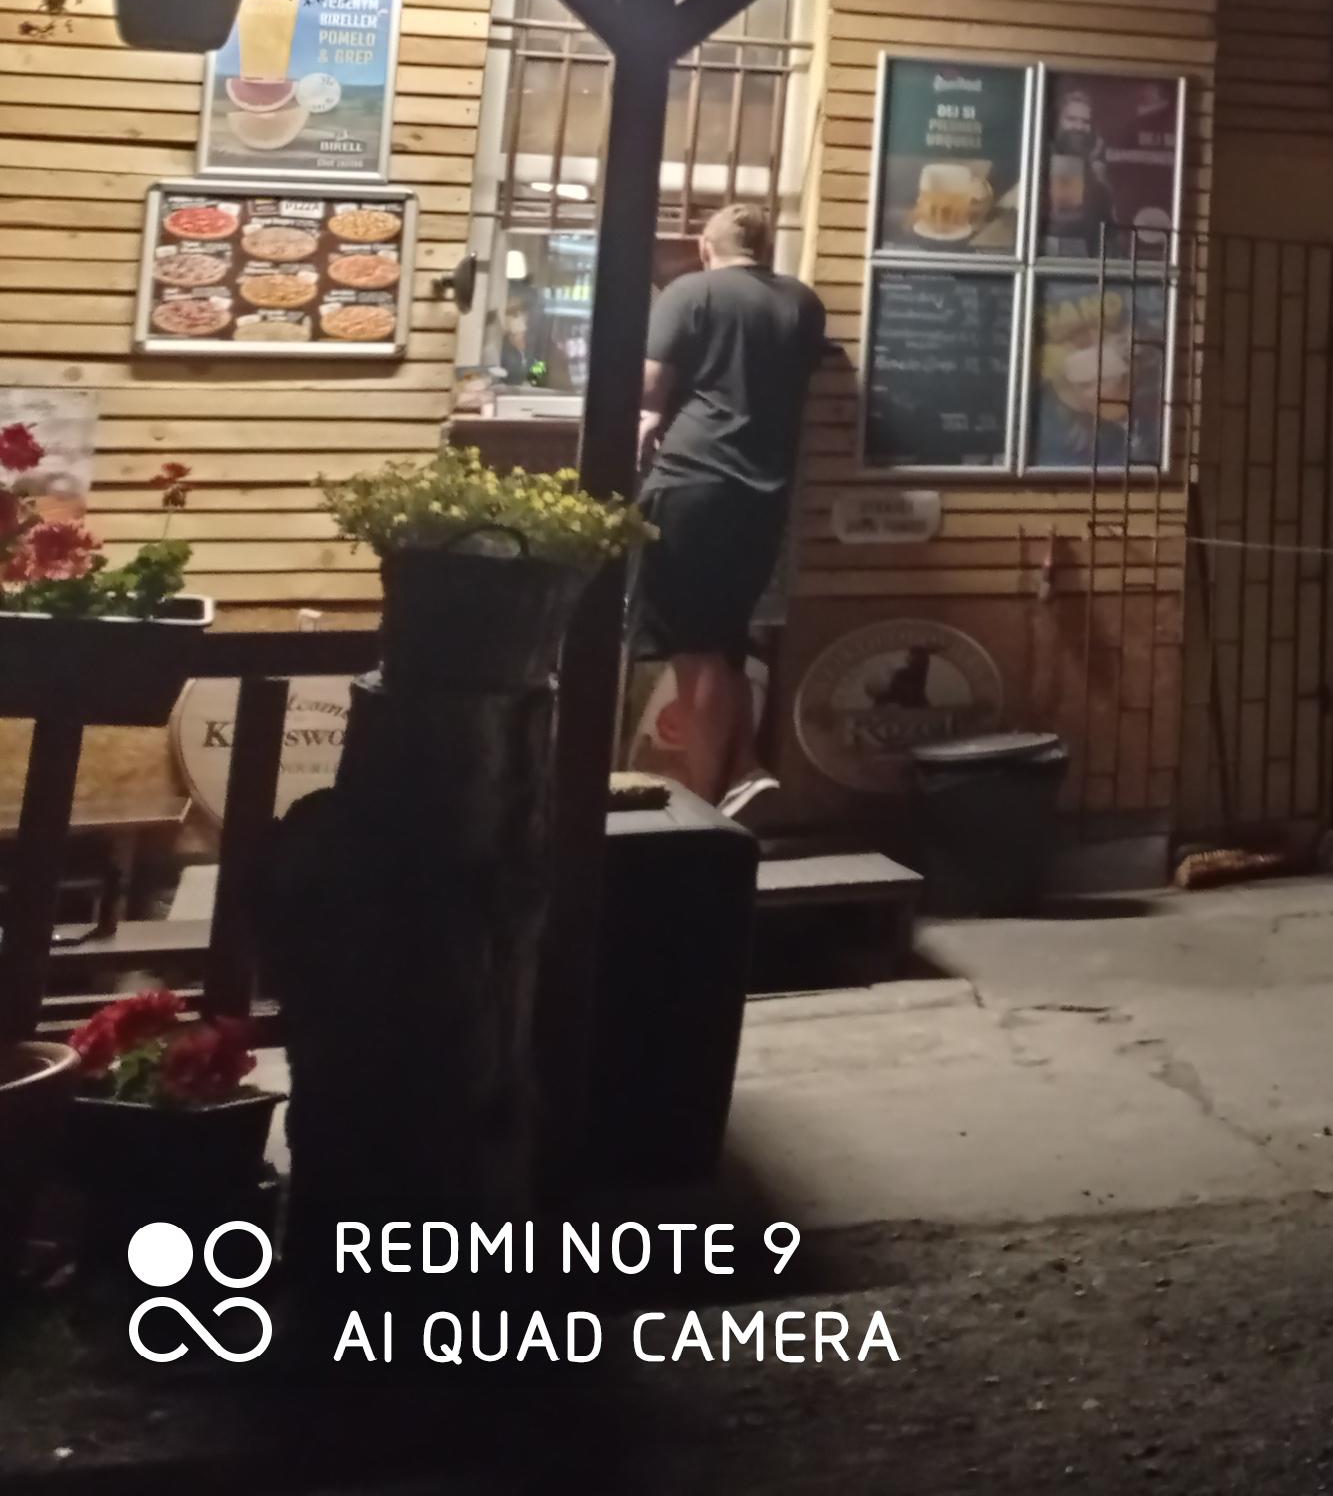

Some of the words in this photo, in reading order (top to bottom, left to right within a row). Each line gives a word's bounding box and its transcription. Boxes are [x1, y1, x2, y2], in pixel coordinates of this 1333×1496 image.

[319, 11, 379, 29] BIRELLEM
[319, 30, 376, 47] POMELO
[318, 48, 329, 64] &
[334, 49, 373, 65] GREP
[319, 141, 364, 153] BIRELL
